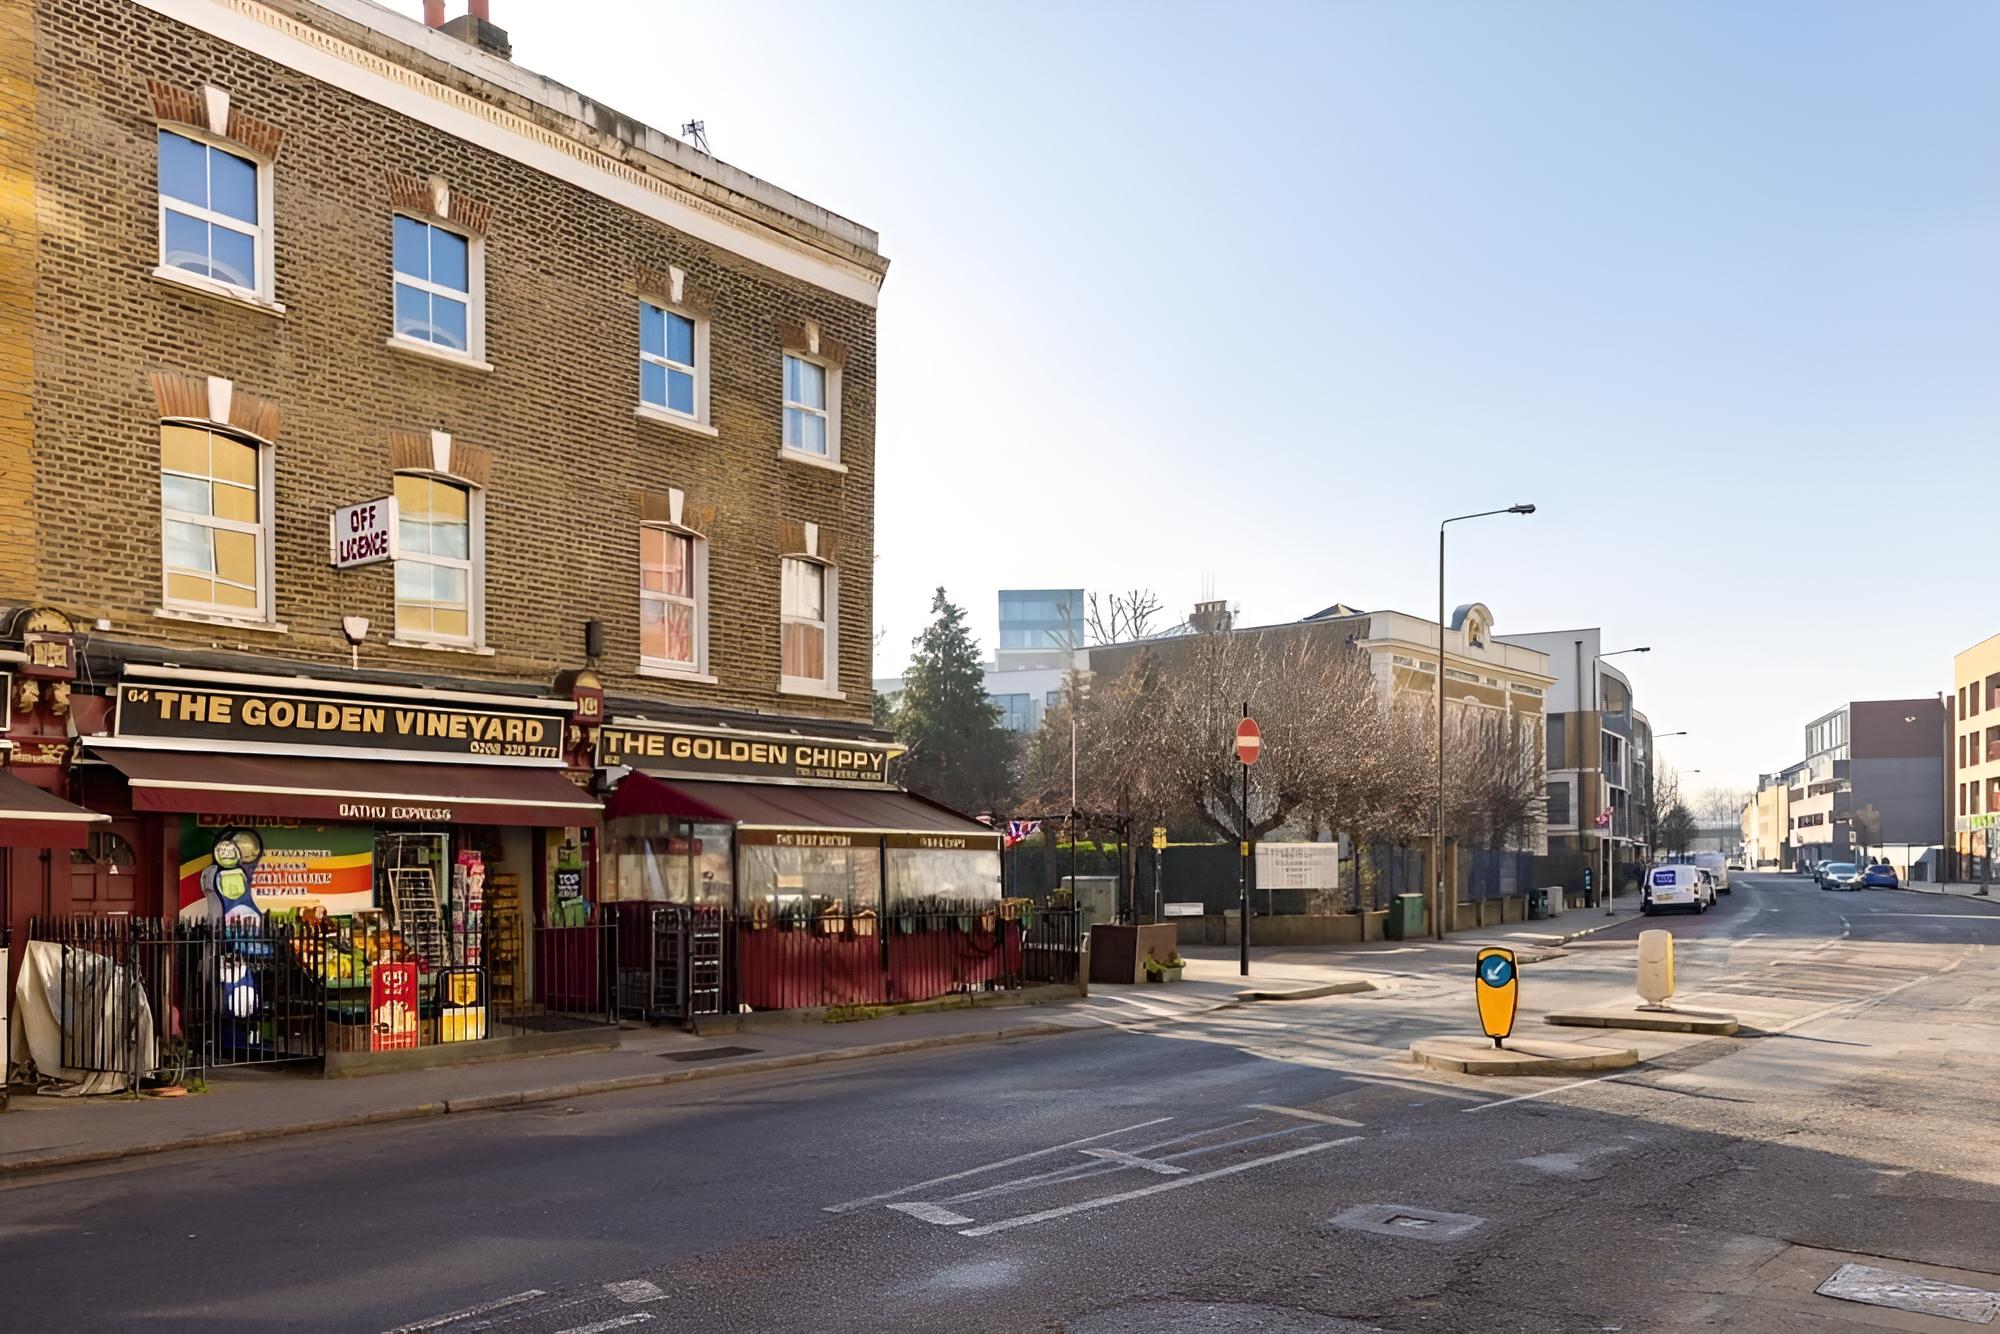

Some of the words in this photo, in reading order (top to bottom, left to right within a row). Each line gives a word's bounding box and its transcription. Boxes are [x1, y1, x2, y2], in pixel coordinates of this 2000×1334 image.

[351, 505, 376, 532] OFF
[340, 530, 388, 562] LICENCE
[155, 692, 232, 724] THE
[241, 699, 385, 734] GOLDEN
[395, 710, 544, 743] VINEYARD
[604, 731, 665, 756] THE
[671, 736, 788, 765] GOLDEN
[795, 746, 882, 772] CHIPPY
